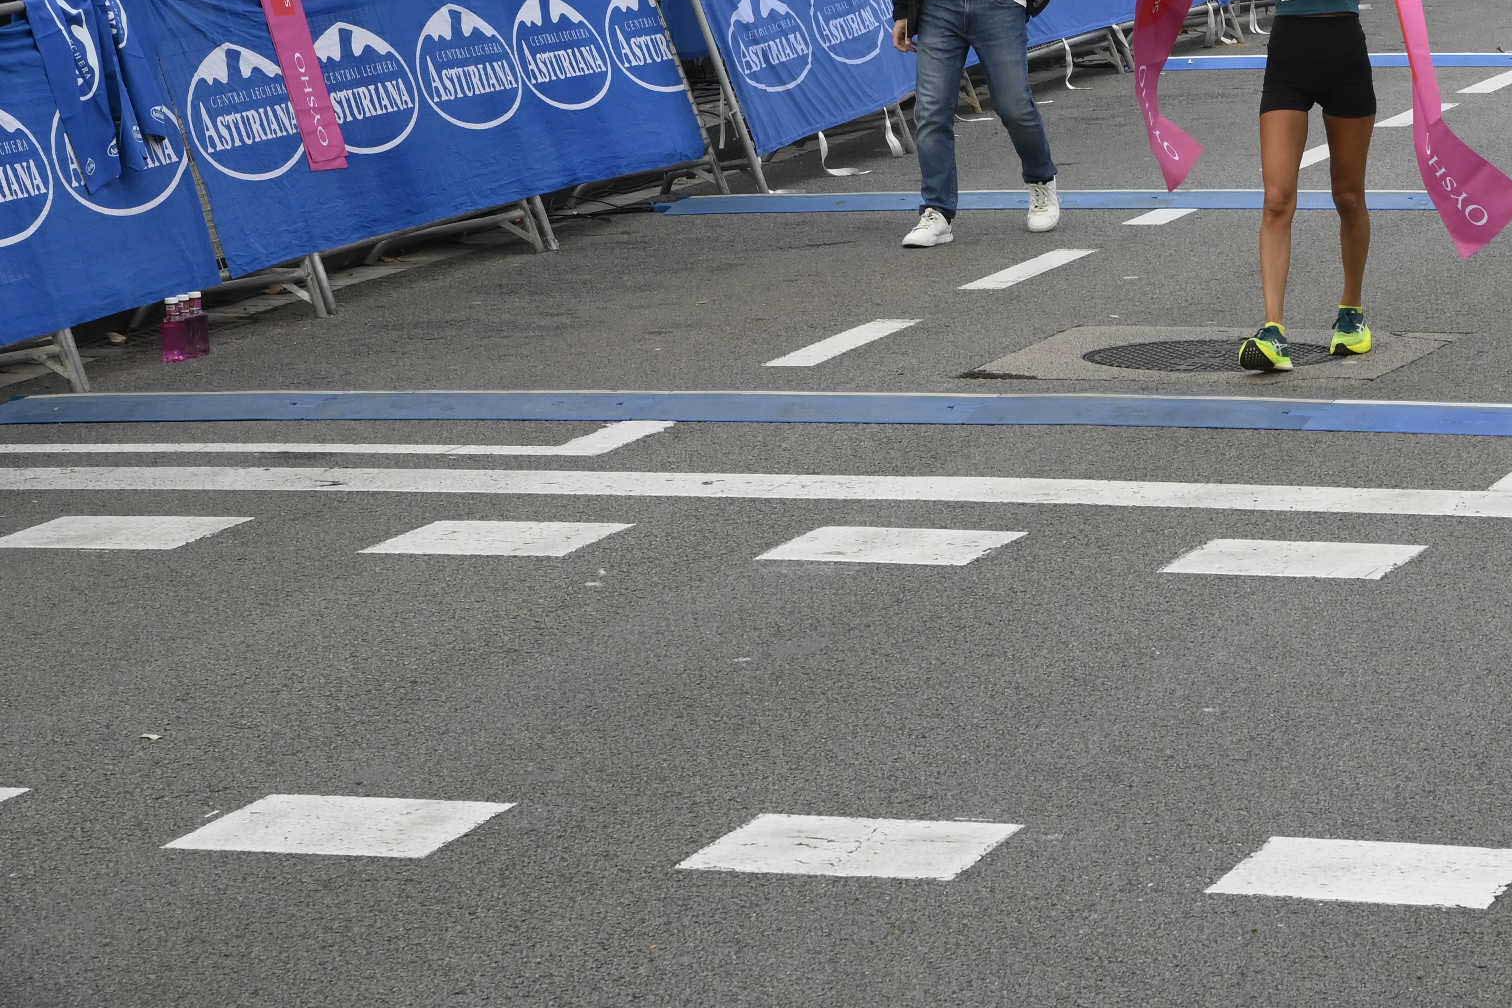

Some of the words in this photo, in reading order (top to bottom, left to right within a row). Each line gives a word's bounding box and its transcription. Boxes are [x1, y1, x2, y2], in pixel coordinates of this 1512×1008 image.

[436, 47, 470, 62] CENTRAL
[471, 42, 502, 57] LECHERA
[529, 33, 558, 47] CENTRAL
[559, 29, 590, 42] LECHERA
[614, 25, 675, 67] ASTUR
[323, 70, 360, 85] CENTRAL
[361, 60, 399, 77] LECHERA
[425, 55, 519, 103] ASTURIANA
[521, 39, 607, 85] ASTURIANA
[210, 91, 250, 109] CENTRAL
[329, 77, 414, 124] STURIANA
[200, 102, 300, 153] ASTURIANA
